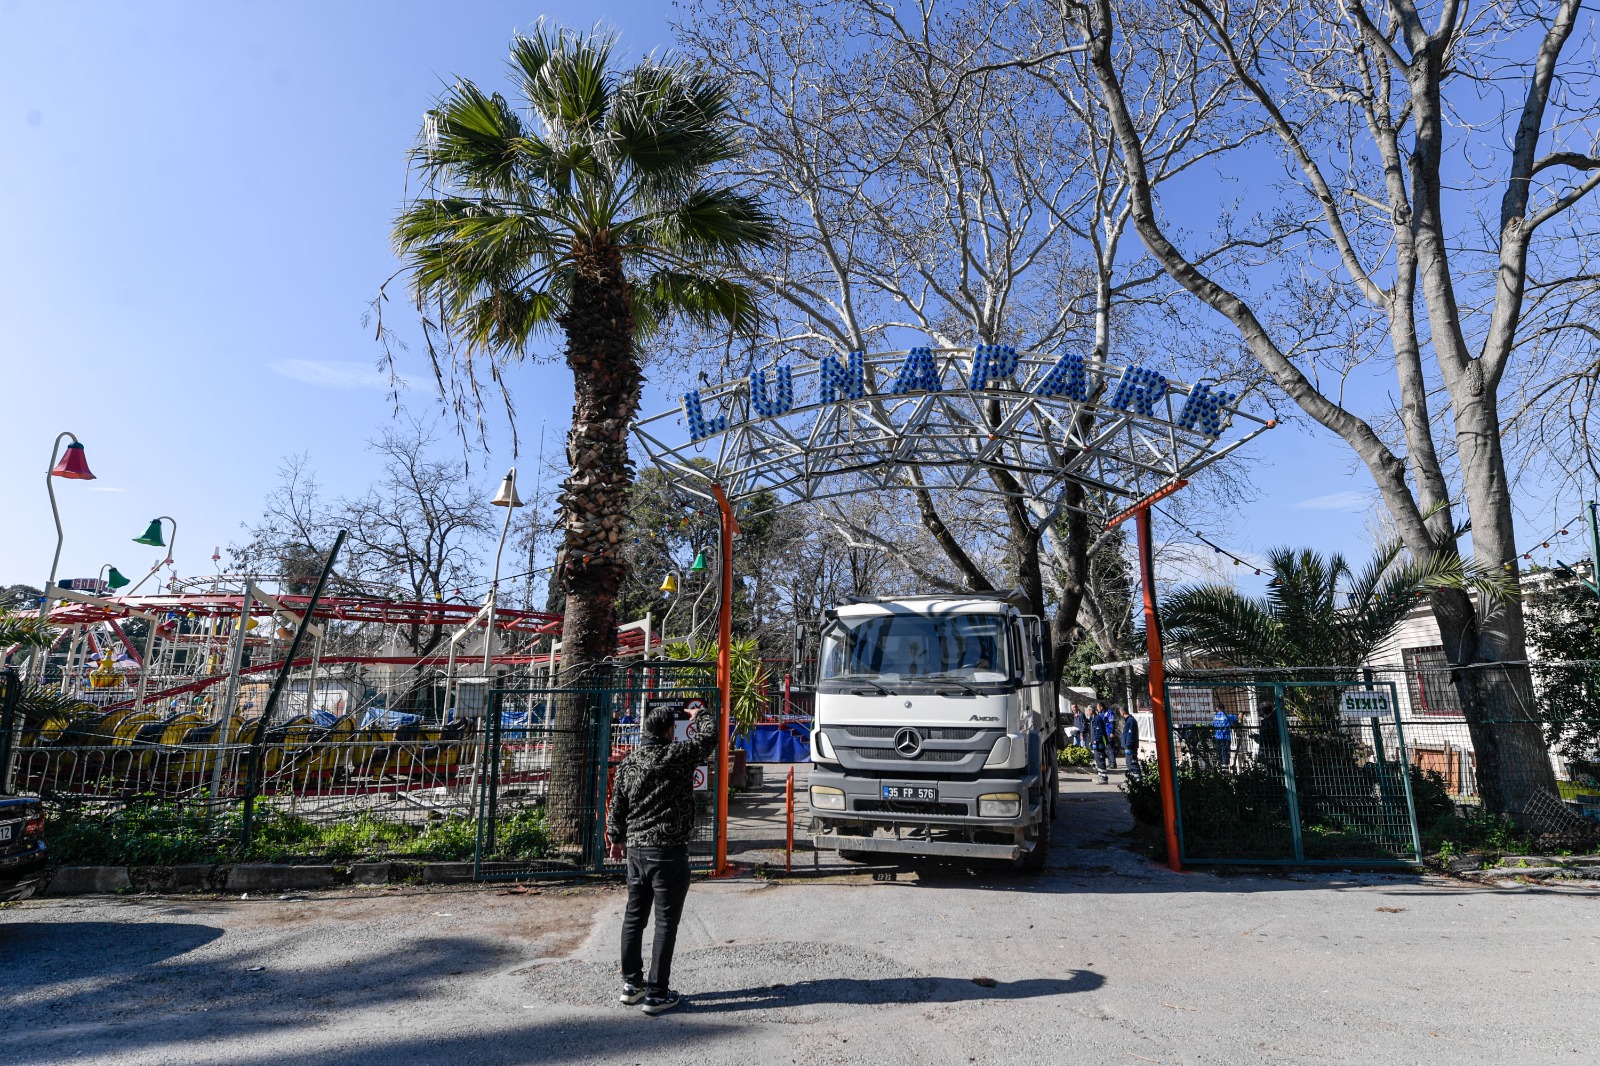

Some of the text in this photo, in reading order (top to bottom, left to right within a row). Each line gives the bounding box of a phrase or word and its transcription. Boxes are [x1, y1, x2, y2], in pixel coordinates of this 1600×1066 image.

[681, 344, 1236, 442] LUNAPARK
[1345, 695, 1388, 710] ÇIKIŞ
[888, 787, 934, 799] 35 FP 576
